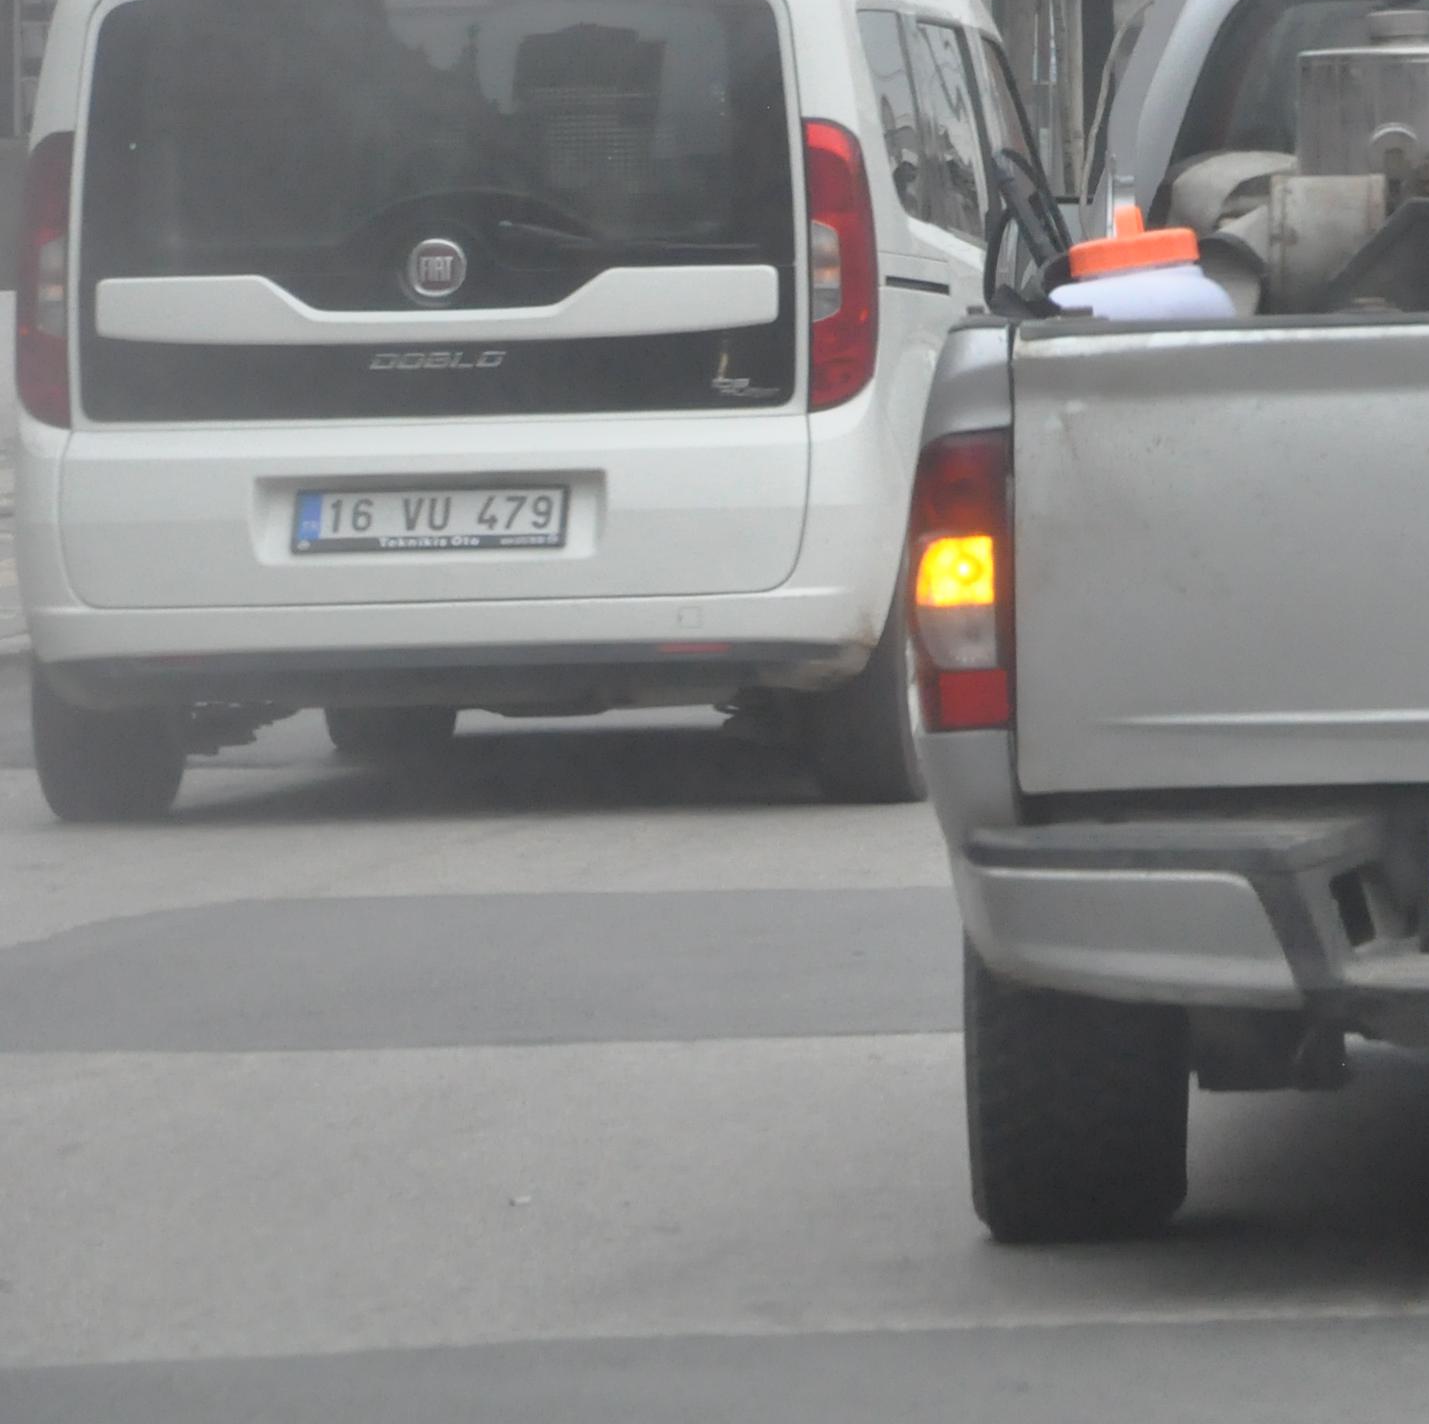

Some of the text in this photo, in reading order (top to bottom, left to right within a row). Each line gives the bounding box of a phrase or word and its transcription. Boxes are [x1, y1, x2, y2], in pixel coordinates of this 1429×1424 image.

[419, 256, 454, 282] FIAT
[330, 499, 373, 533] 16
[402, 496, 452, 532] VU
[477, 494, 555, 530] 479
